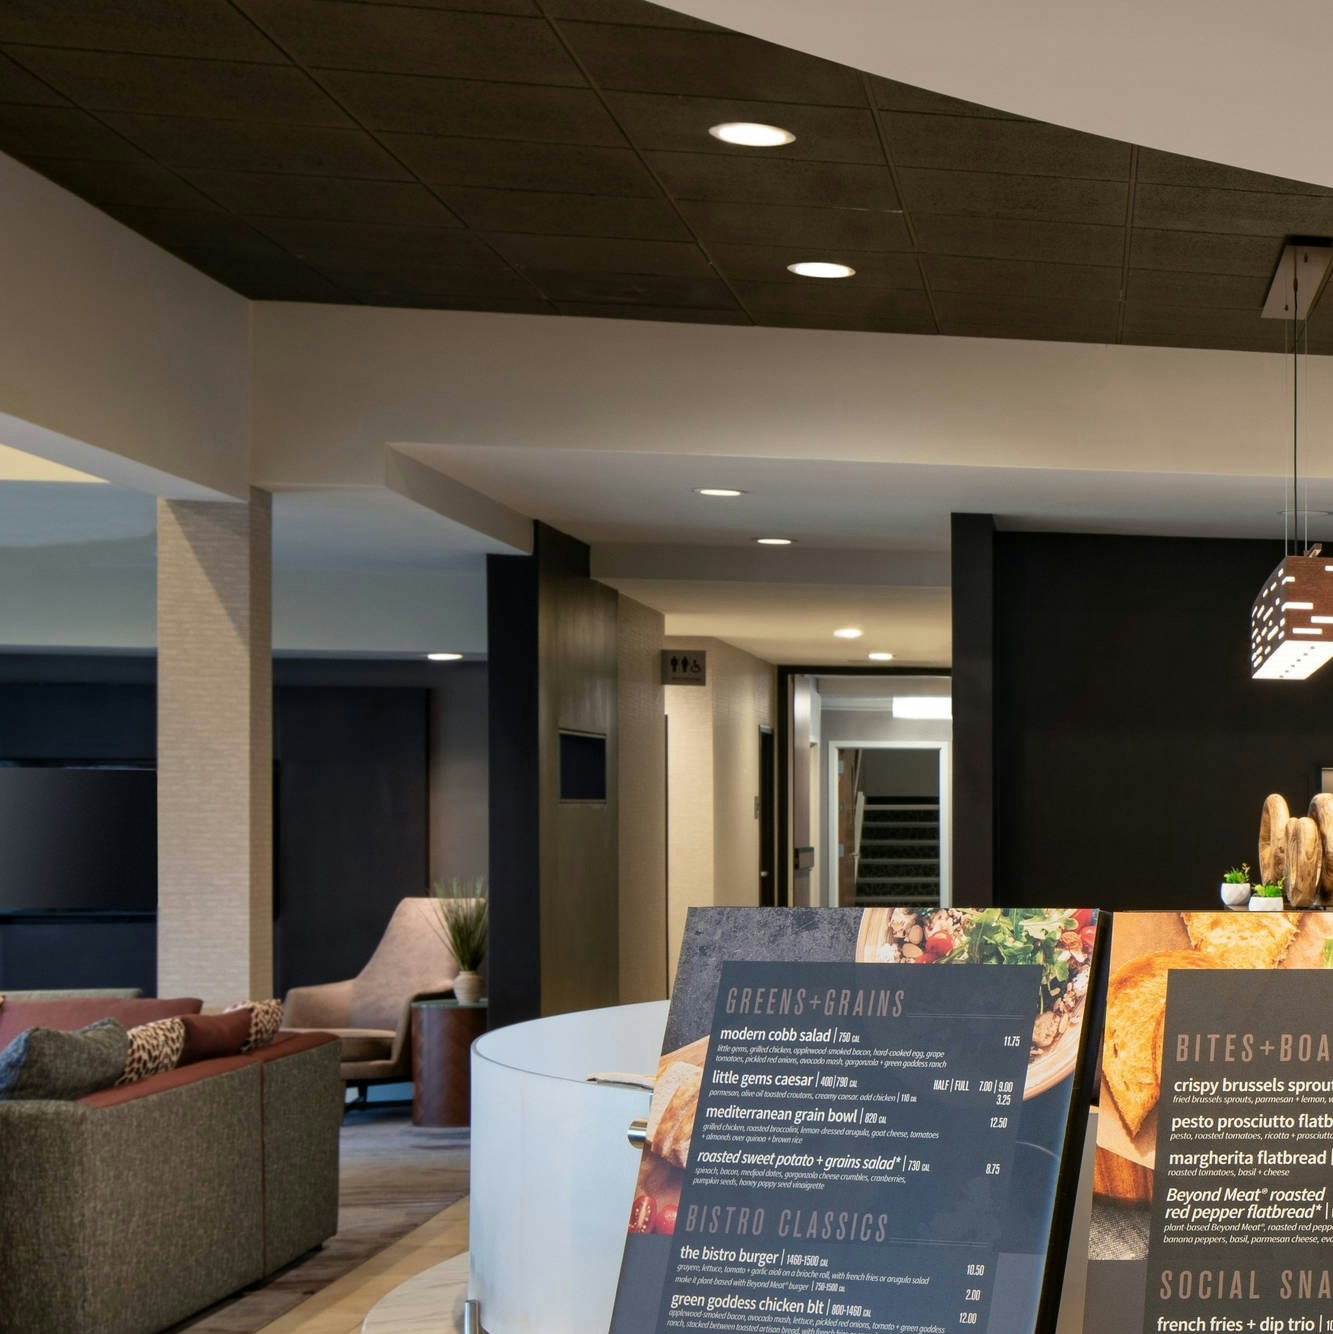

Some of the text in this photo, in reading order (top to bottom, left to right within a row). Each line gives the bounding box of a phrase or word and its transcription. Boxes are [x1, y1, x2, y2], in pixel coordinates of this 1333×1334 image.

[720, 1026, 832, 1042] modern cobb salad
[1004, 1036, 1020, 1047] 11.75
[712, 1069, 814, 1088] little gems caesar
[1174, 1077, 1219, 1095] crispy
[1222, 1077, 1285, 1092] brussels
[706, 1104, 858, 1125] mediterranean grain bowl
[990, 1117, 1008, 1128] 12.50
[1171, 1115, 1214, 1132] pesto
[1217, 1113, 1295, 1132] prosciutto
[697, 1150, 740, 1164] roasted
[741, 1154, 774, 1165] sweet
[774, 1153, 814, 1169] potato
[823, 1154, 862, 1171] grains
[1169, 1150, 1327, 1168] margherita flatbread
[1166, 1187, 1222, 1204] Beyond
[1269, 1186, 1326, 1202] roasted
[1165, 1202, 1191, 1219] red
[1191, 1208, 1246, 1222] pepper
[685, 1205, 888, 1242] BISTRO CLASSICS
[680, 1245, 779, 1267] the bistro burger
[1160, 1270, 1260, 1300] SOCIAL
[670, 1294, 825, 1315] green goddess chicken blt
[1157, 1316, 1206, 1332] french
[1210, 1316, 1243, 1332] fries
[1259, 1316, 1284, 1334] dip
[1287, 1316, 1315, 1331] trio
